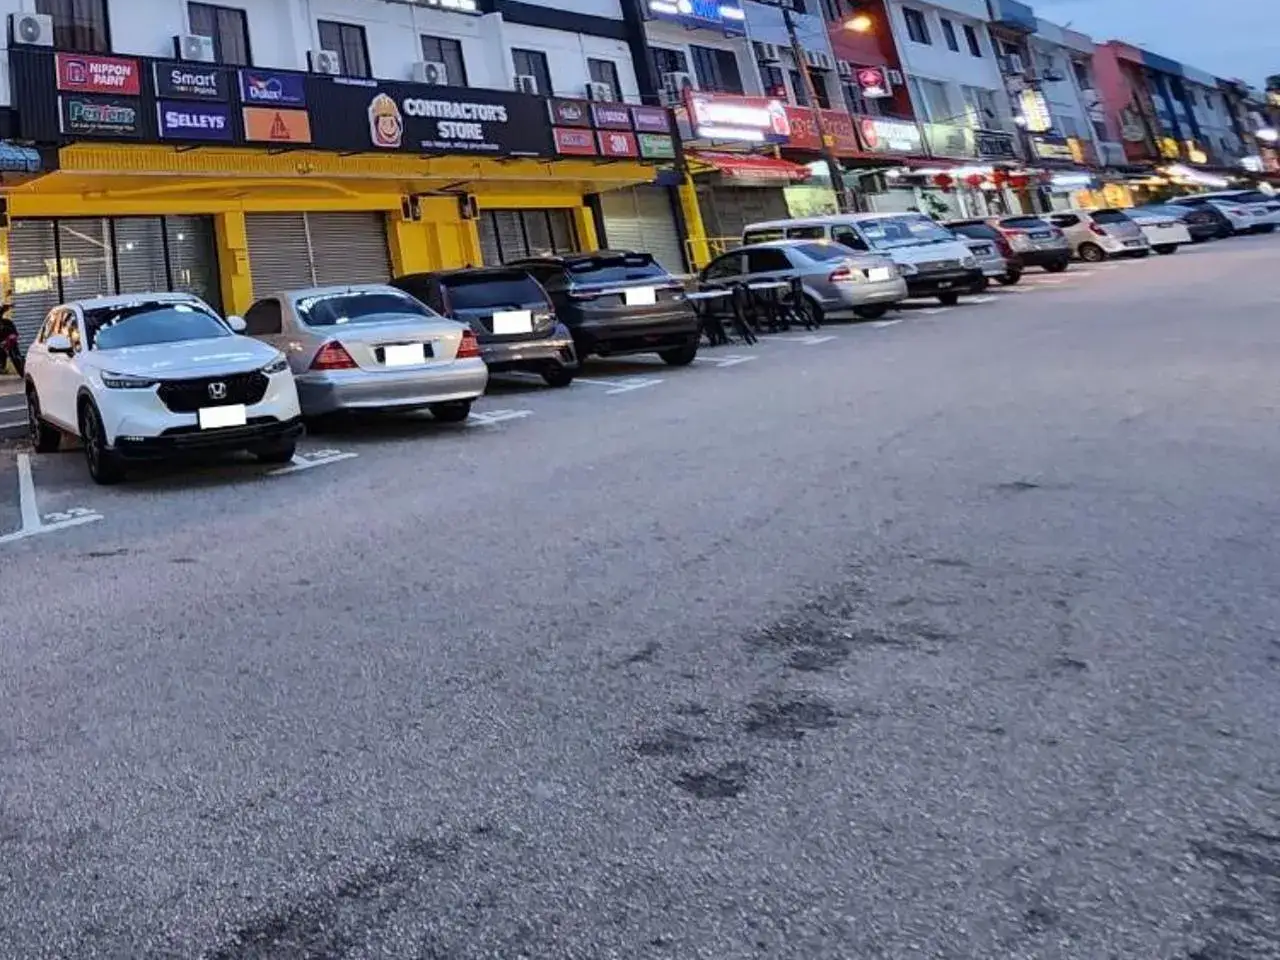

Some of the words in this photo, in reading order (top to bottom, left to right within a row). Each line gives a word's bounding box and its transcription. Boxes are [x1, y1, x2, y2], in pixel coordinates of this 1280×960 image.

[90, 62, 131, 76] NIPPON
[171, 69, 217, 87] Smart
[93, 74, 125, 86] PAINT
[402, 98, 508, 123] CONTRACTOR'S
[436, 120, 484, 140] STORE
